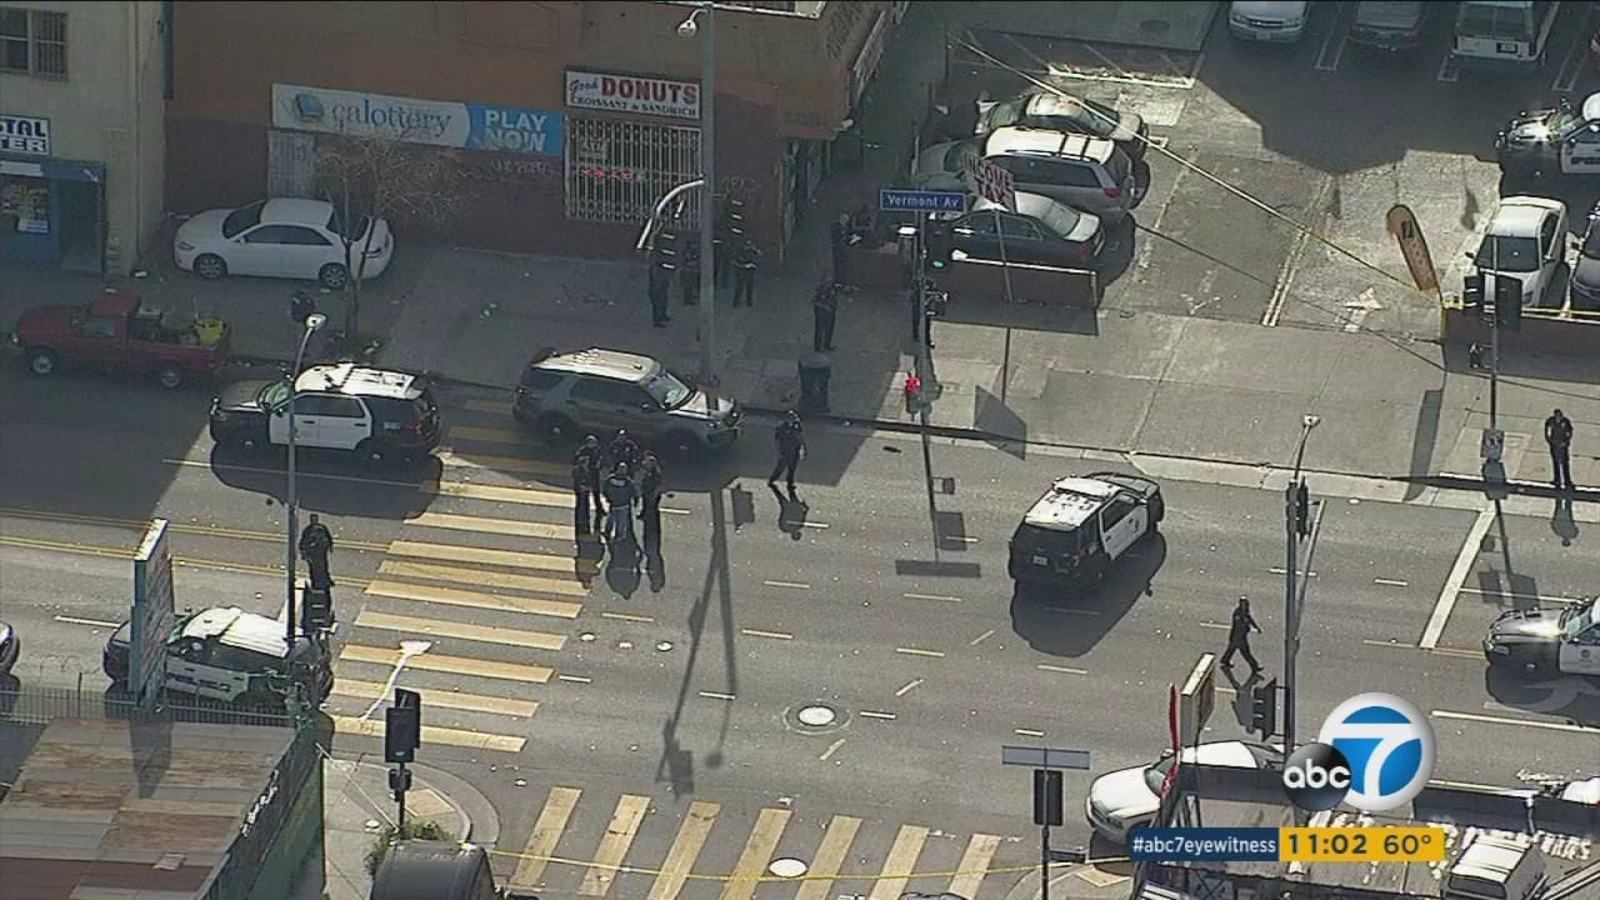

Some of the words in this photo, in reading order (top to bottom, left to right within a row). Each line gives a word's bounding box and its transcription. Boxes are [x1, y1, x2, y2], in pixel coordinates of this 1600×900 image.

[602, 77, 697, 105] DONUTS
[485, 108, 548, 131] PLAY
[485, 128, 547, 152] NOW
[887, 194, 938, 208] Vermont
[944, 196, 959, 208] Av
